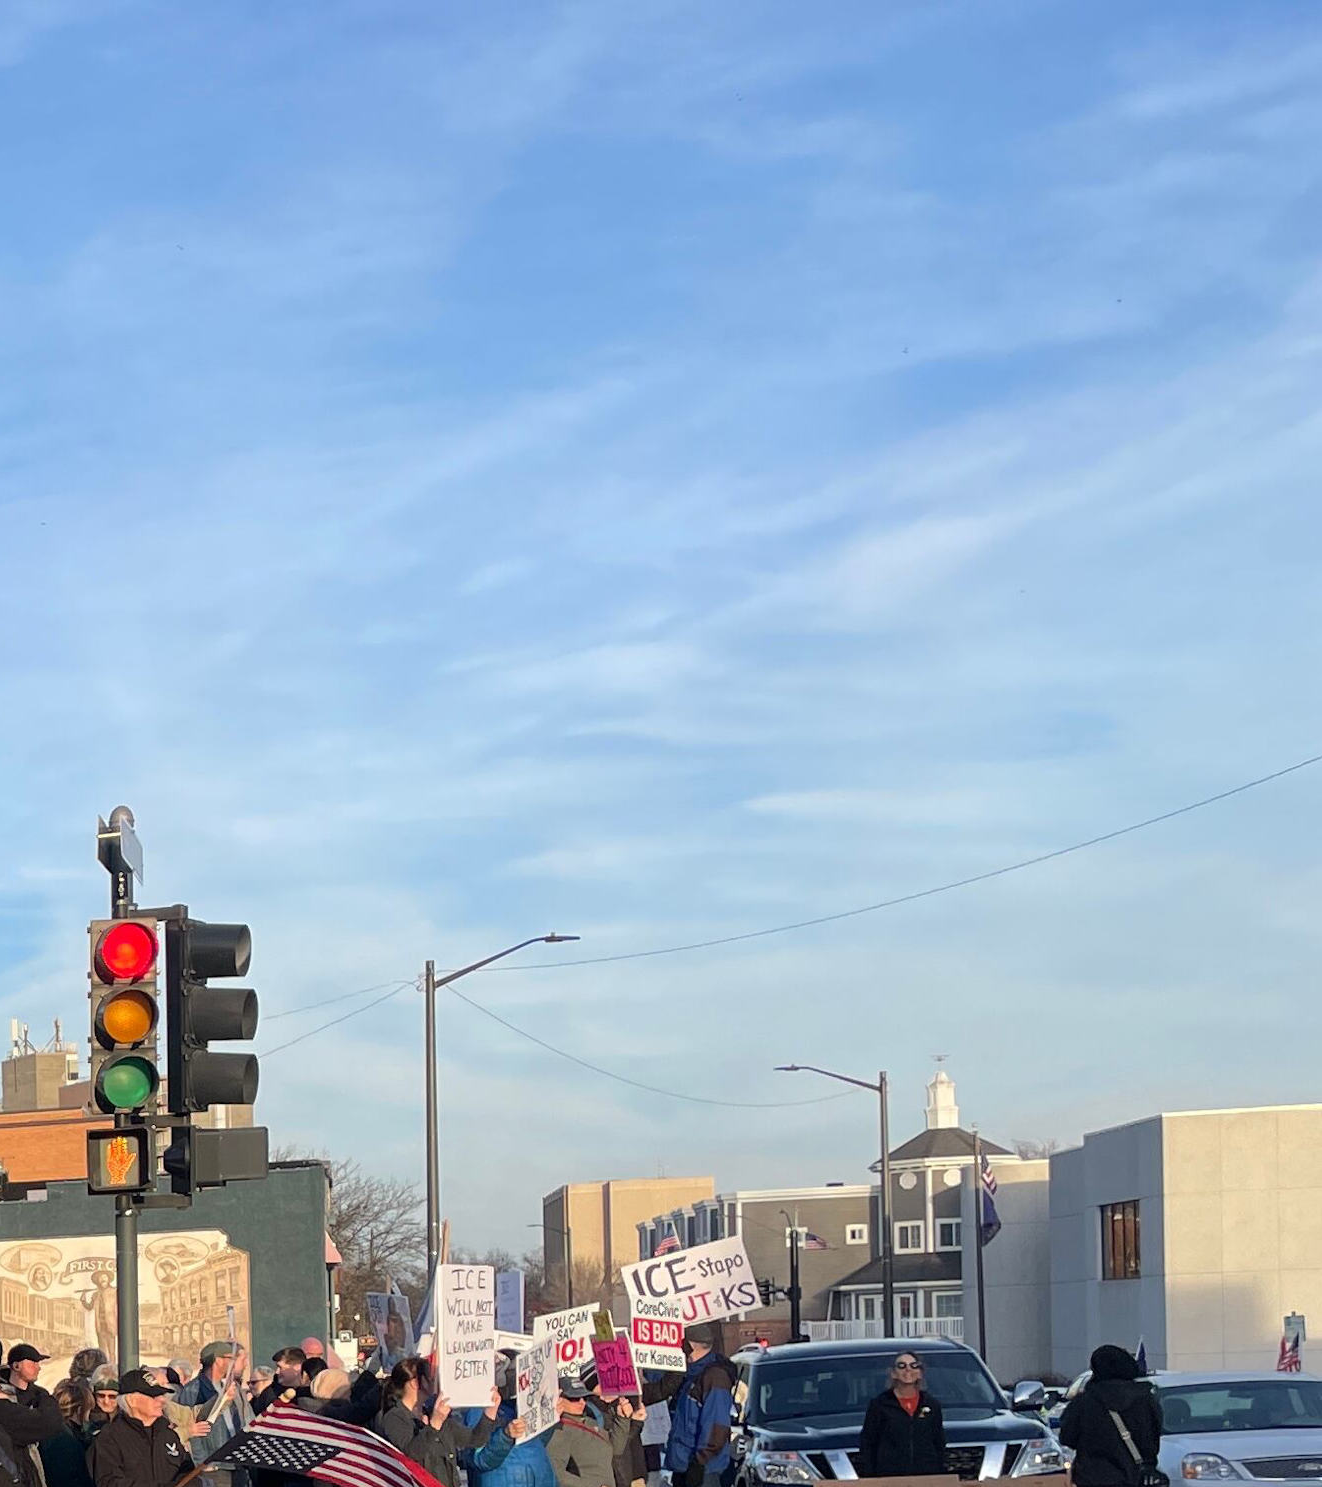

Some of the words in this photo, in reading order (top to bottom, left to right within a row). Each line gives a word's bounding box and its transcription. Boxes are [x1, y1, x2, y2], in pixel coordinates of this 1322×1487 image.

[69, 1260, 103, 1275] FIRST
[452, 1269, 486, 1291] ICE
[720, 1281, 755, 1310] KS
[447, 1299, 473, 1317] WILL
[476, 1300, 494, 1316] NOT
[636, 1299, 680, 1318] CoreCivic
[457, 1320, 484, 1335] MAKE
[545, 1315, 566, 1331] YOU
[568, 1309, 589, 1324] CAN
[557, 1326, 576, 1342] SAY
[638, 1321, 650, 1341] IS
[652, 1322, 678, 1345] BAD
[446, 1338, 494, 1355] LEAVENWORTH
[635, 1348, 648, 1364] for
[650, 1349, 684, 1367] Kansas
[454, 1360, 488, 1380] BETTER
